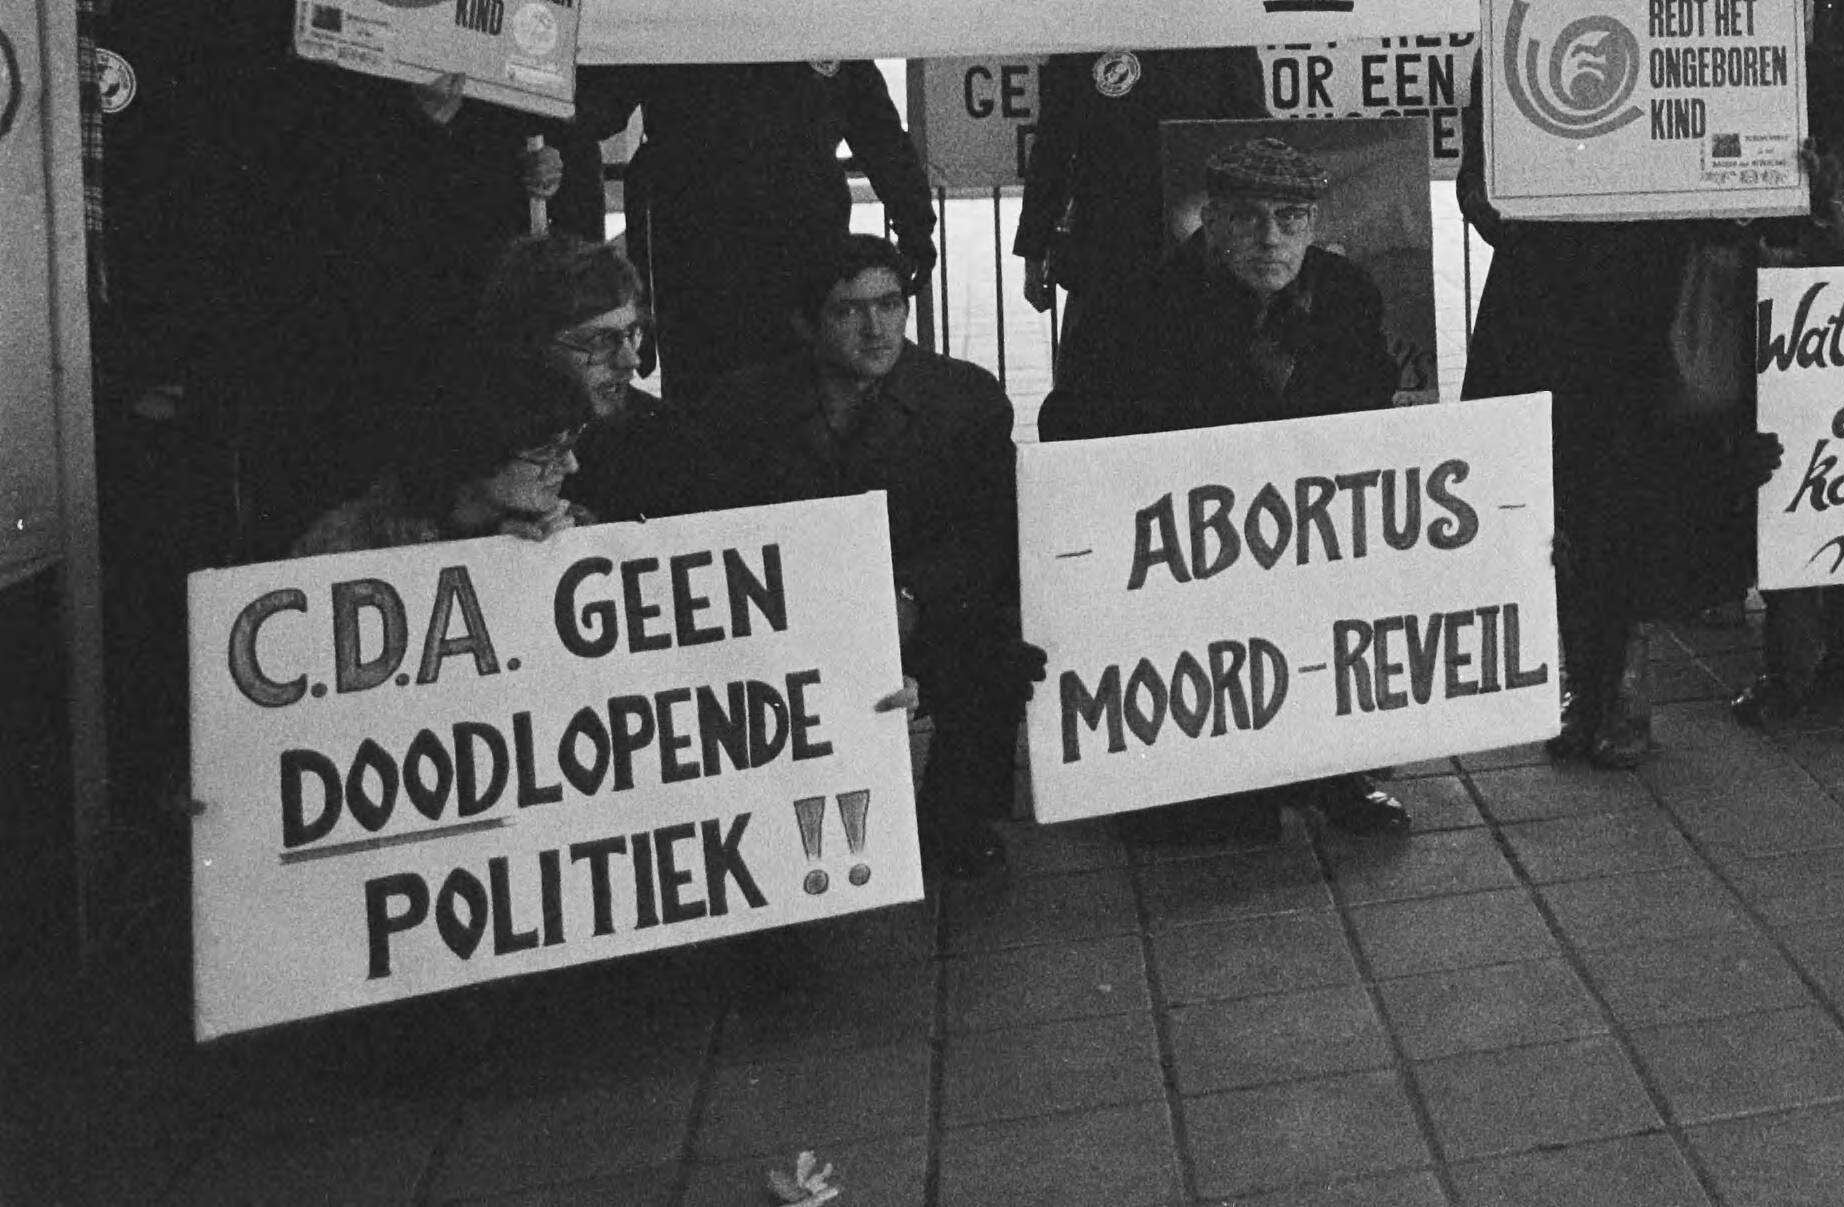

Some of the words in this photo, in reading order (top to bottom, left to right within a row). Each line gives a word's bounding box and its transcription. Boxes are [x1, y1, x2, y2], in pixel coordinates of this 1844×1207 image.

[1361, 52, 1455, 107] EEN
[1650, 46, 1788, 89] ONGEBOREN
[1650, 98, 1706, 140] KIND
[1127, 458, 1480, 591] ABORTUS
[228, 564, 523, 709] C.D.A.
[553, 541, 790, 659] GEEN
[280, 668, 834, 849] DOODLOPENDE
[365, 811, 769, 981] POLITIEK
